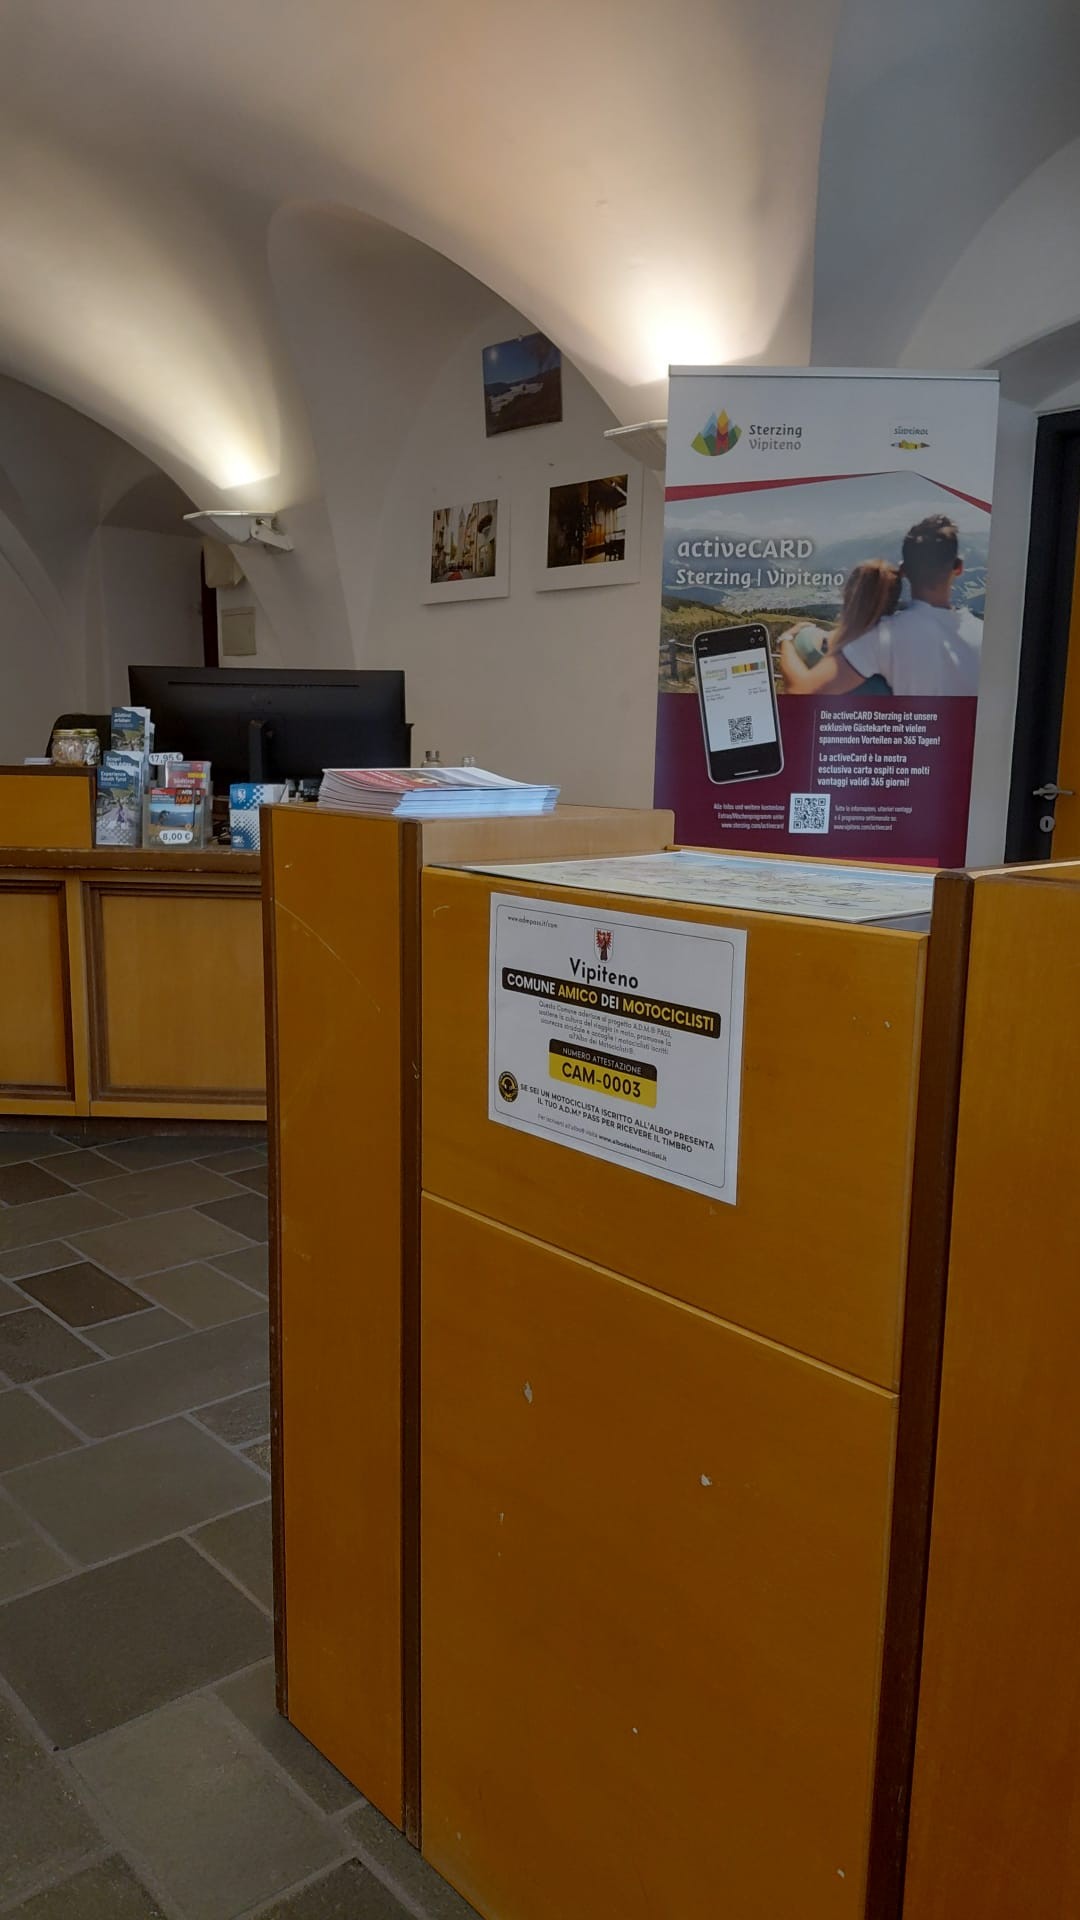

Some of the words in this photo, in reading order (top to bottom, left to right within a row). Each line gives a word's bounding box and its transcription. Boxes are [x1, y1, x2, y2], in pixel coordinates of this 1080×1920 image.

[749, 424, 802, 438] Sterzing
[749, 438, 801, 452] Vipiteno
[677, 536, 813, 558] activeCARD
[676, 568, 751, 588] Sterzing
[766, 568, 844, 588] Vipiteno
[821, 711, 832, 720] Die
[833, 711, 872, 720] activeCARD
[873, 711, 902, 722] Sterzing
[903, 712, 913, 721] ist
[913, 713, 938, 721] unsere
[819, 723, 852, 732] exklusive
[853, 723, 891, 733] Gästekarte
[892, 724, 904, 733] mit
[905, 724, 927, 733] vielen
[819, 736, 860, 746] spannenden
[861, 736, 893, 745] Vorteilen
[893, 737, 903, 745] an
[903, 736, 916, 745] 365
[918, 736, 940, 747] Tagen!
[819, 753, 828, 762] La
[828, 753, 867, 762] activeCard
[868, 754, 873, 762] è
[875, 754, 882, 762] la
[883, 755, 907, 763] nostra
[818, 765, 852, 774] esclusiva
[853, 766, 872, 774] carta
[873, 766, 894, 776] ospiti
[896, 767, 909, 775] con
[910, 766, 930, 775] molti
[817, 777, 848, 787] vantaggi
[849, 777, 869, 786] validi
[871, 777, 884, 786] 365
[885, 778, 910, 788] giorni!
[184, 833, 191, 841] €
[569, 957, 639, 989] Vipiteno
[507, 973, 556, 995] COMUNE
[557, 984, 598, 1004] AMICO
[601, 993, 619, 1010] DEI
[622, 998, 714, 1032] MOTOCICLISTI
[538, 1000, 556, 1010] Questo
[556, 1004, 577, 1015] Comune
[607, 1017, 632, 1029] progetto
[584, 1018, 593, 1027] del
[562, 1048, 591, 1061] NUMERO
[592, 1055, 642, 1075] ATTESTAZIONE
[562, 1062, 641, 1098] CAM-0003
[520, 1084, 528, 1092] SE
[529, 1086, 540, 1095] SEI
[541, 1090, 550, 1098] UN
[551, 1093, 600, 1114] MOTOCICLISTA
[601, 1107, 633, 1124] ISCRITTO
[673, 1130, 715, 1151] PRESENTA
[537, 1097, 544, 1106] IL
[544, 1099, 558, 1109] TUO
[582, 1111, 600, 1124] PASS
[601, 1117, 615, 1129] PER
[617, 1121, 652, 1140] RICEVERE
[653, 1135, 660, 1143] IL
[661, 1138, 693, 1153] TIMBRO
